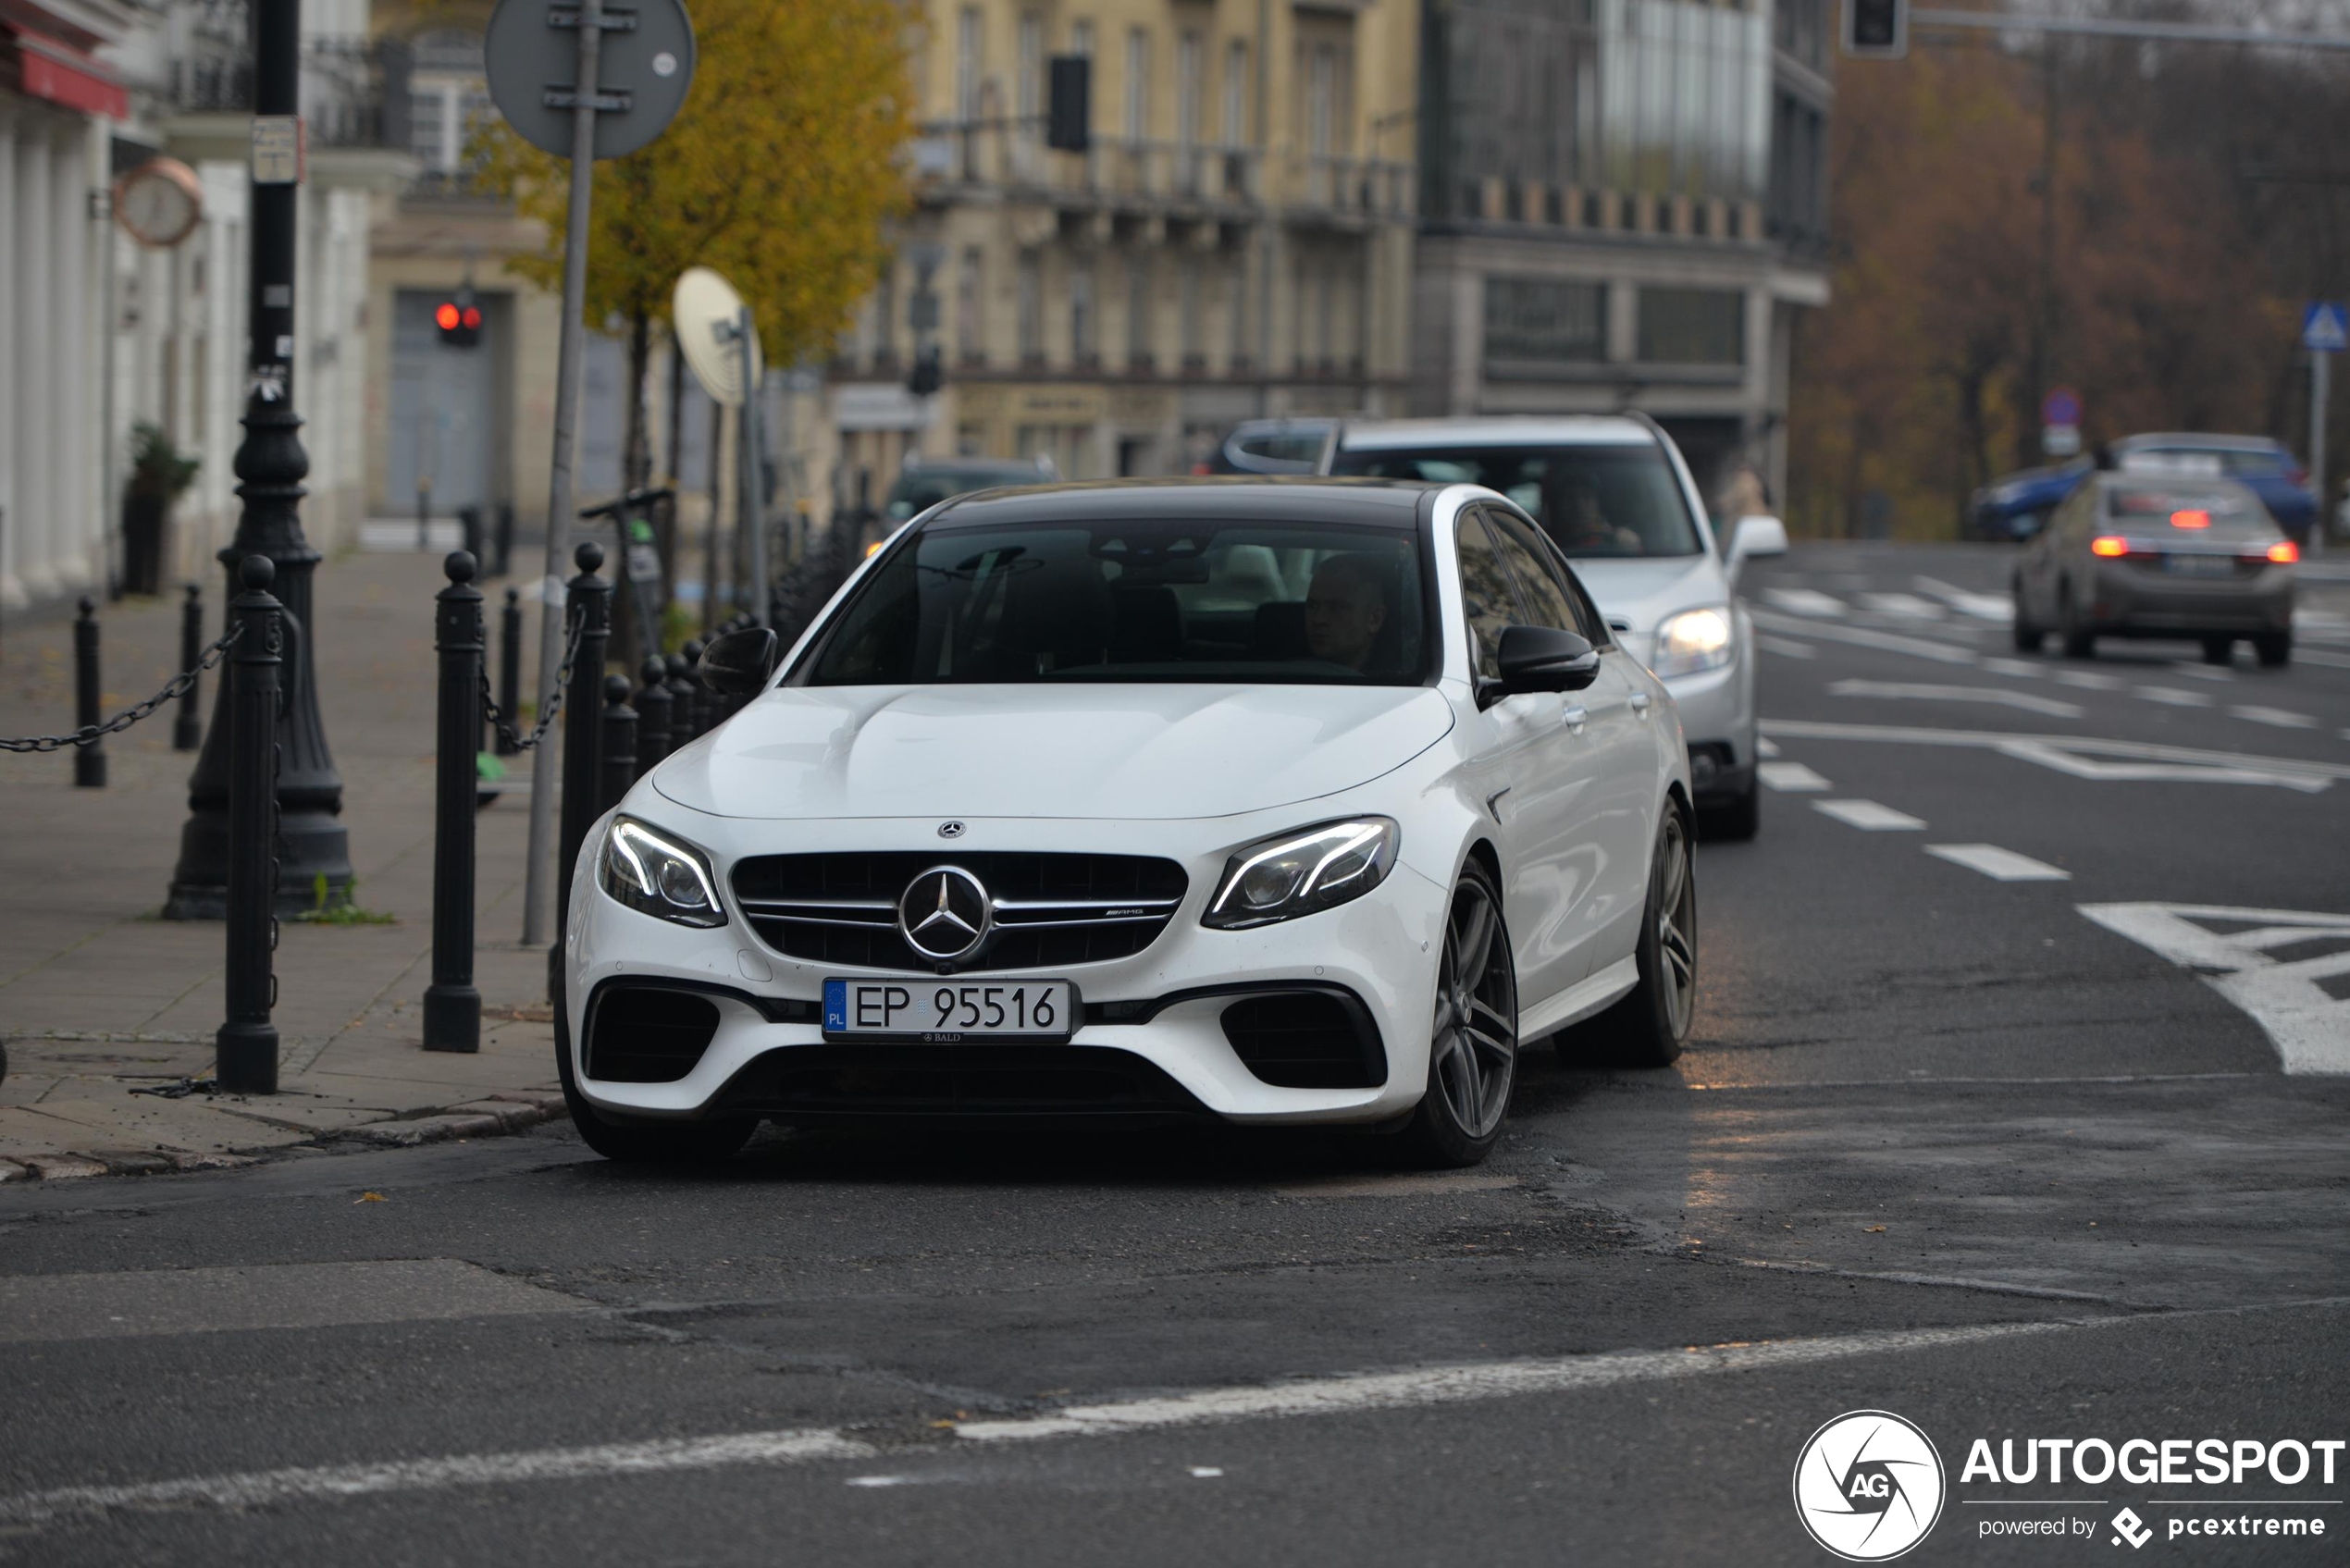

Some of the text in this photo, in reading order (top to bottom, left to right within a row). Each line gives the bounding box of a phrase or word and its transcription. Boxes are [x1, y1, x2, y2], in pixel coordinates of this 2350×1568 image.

[857, 986, 1055, 1028] EP 95516
[829, 1013, 844, 1025] PL
[934, 1033, 961, 1043] BALD
